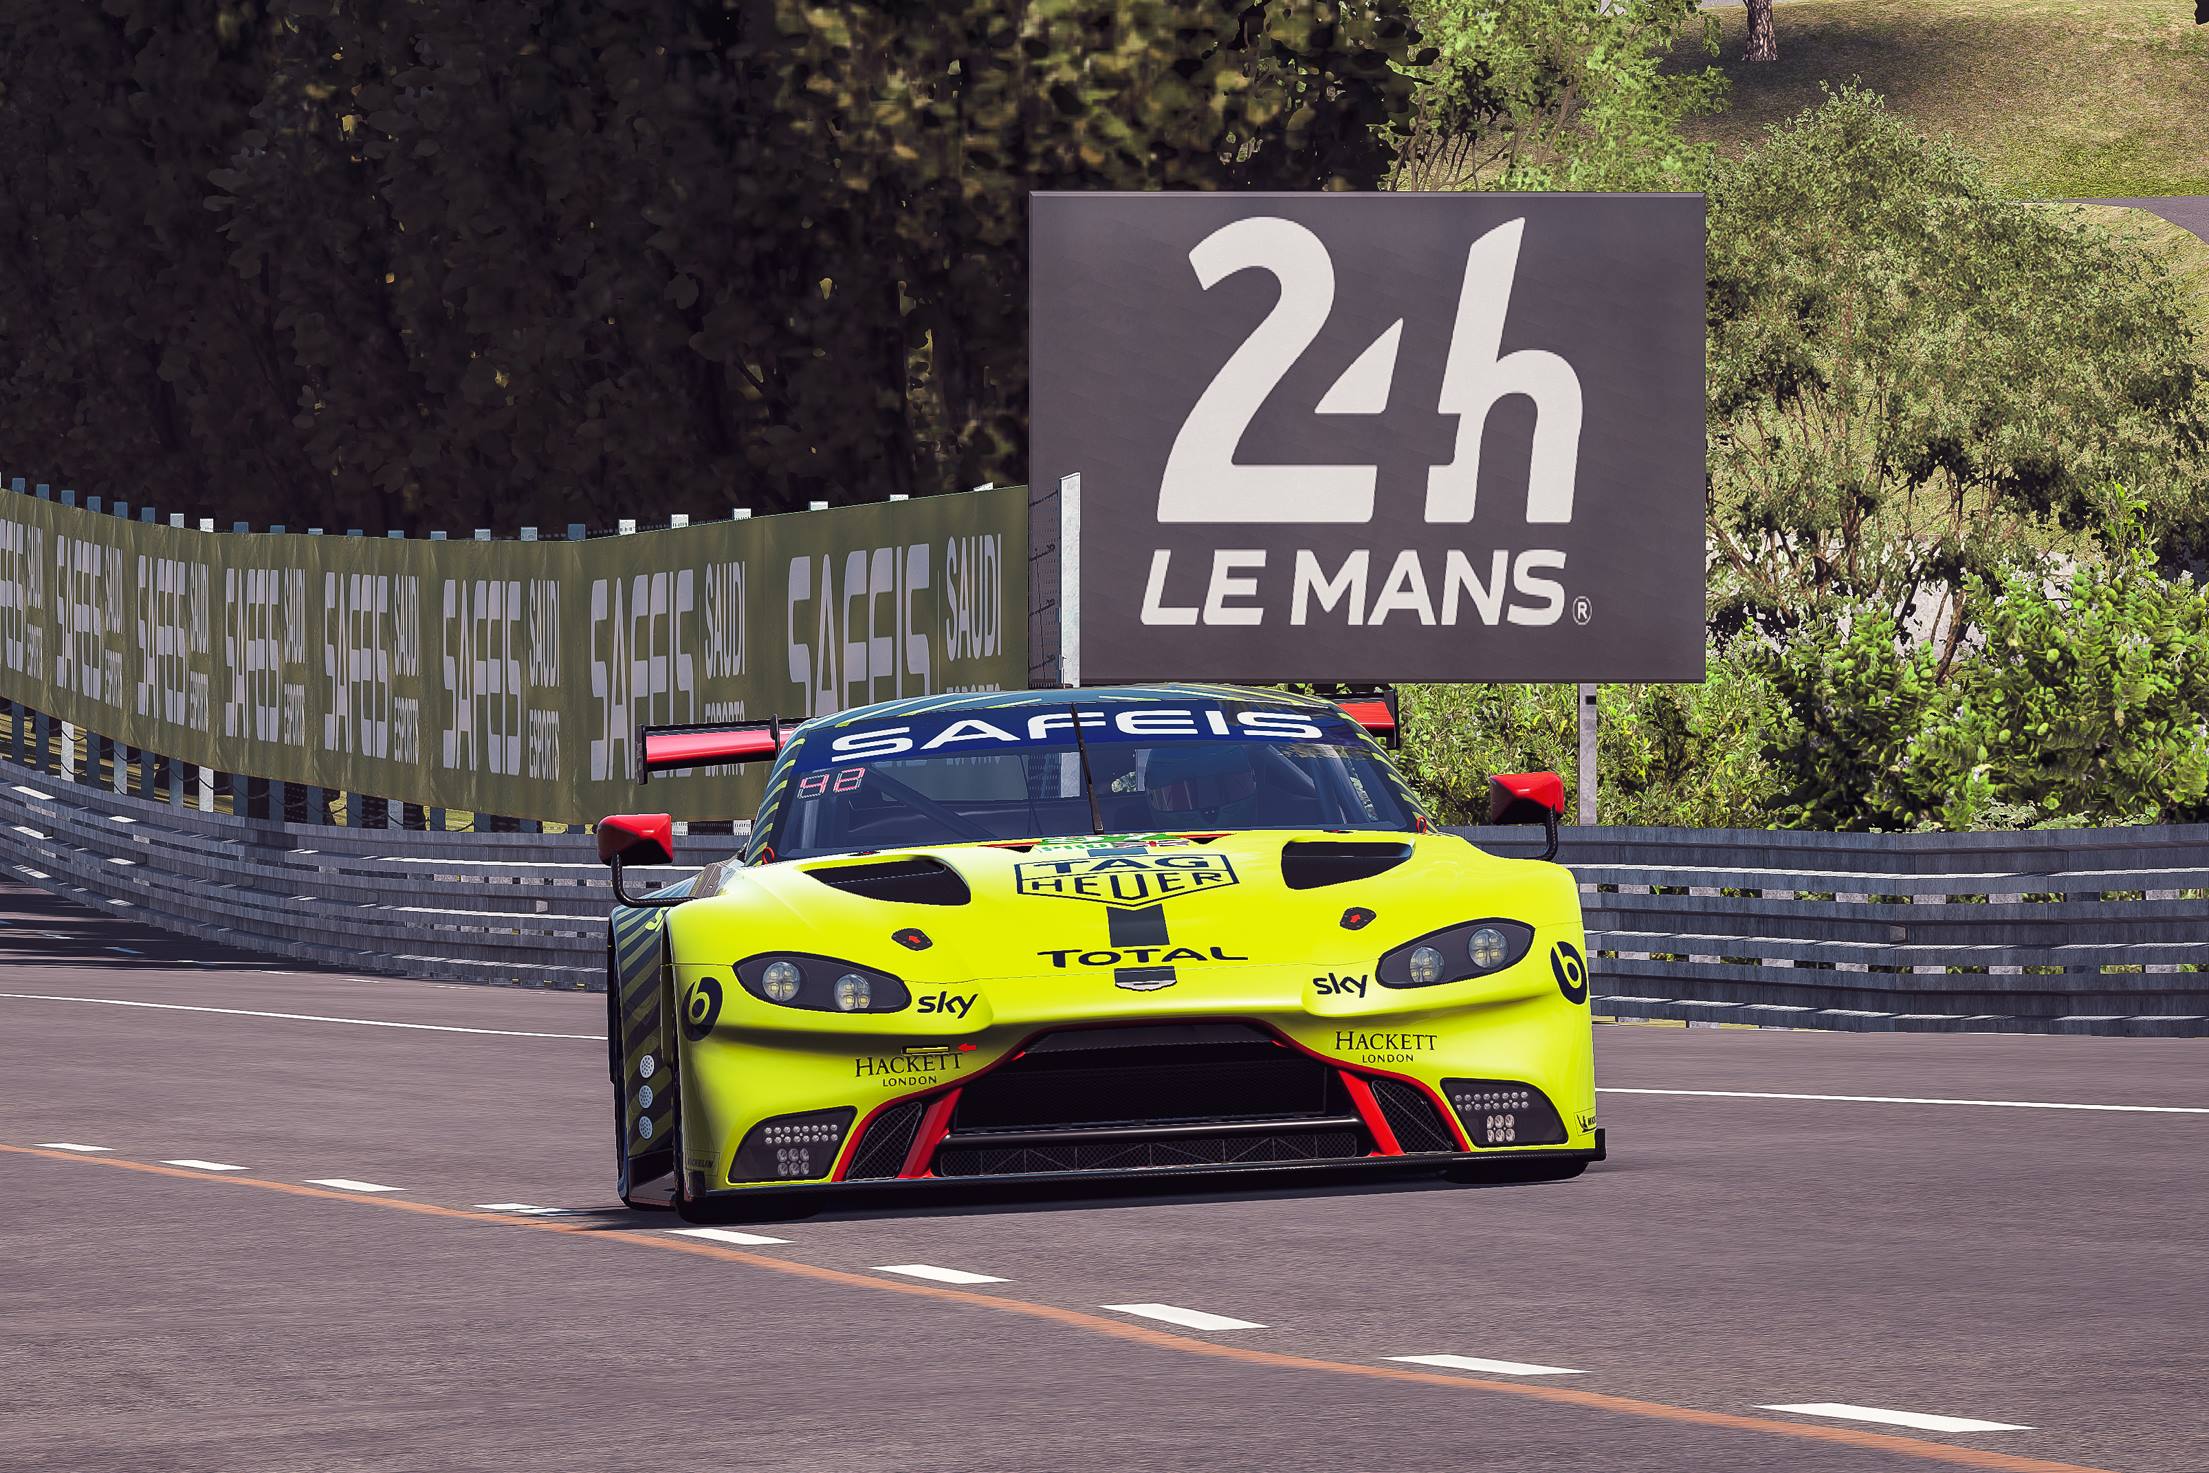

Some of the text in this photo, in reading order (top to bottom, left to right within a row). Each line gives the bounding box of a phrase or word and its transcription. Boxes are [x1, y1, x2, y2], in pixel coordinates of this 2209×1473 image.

[945, 533, 1001, 662] SAUDI
[1140, 549, 1267, 625] LE
[394, 573, 419, 677] SAUDI
[528, 577, 560, 688] SAUDI
[704, 560, 746, 680] SAUDI
[225, 568, 279, 743] SAFEIS
[325, 571, 388, 760] SAFEIS
[443, 578, 521, 776] SAFEIS
[590, 568, 694, 782] SAFEIS
[528, 708, 560, 783] ESPORTS
[831, 709, 1323, 763] SAFEIS
[1031, 871, 1224, 901] HEUER
[1033, 856, 1211, 875] TAG
[1037, 946, 1249, 968] TOTAL
[1312, 972, 1368, 998] sky
[917, 991, 979, 1019] sky
[855, 1053, 963, 1077] HACKETT
[1335, 1031, 1438, 1052] HACKETT
[1362, 1054, 1414, 1064] LONDON
[883, 1075, 937, 1087] LONDON
